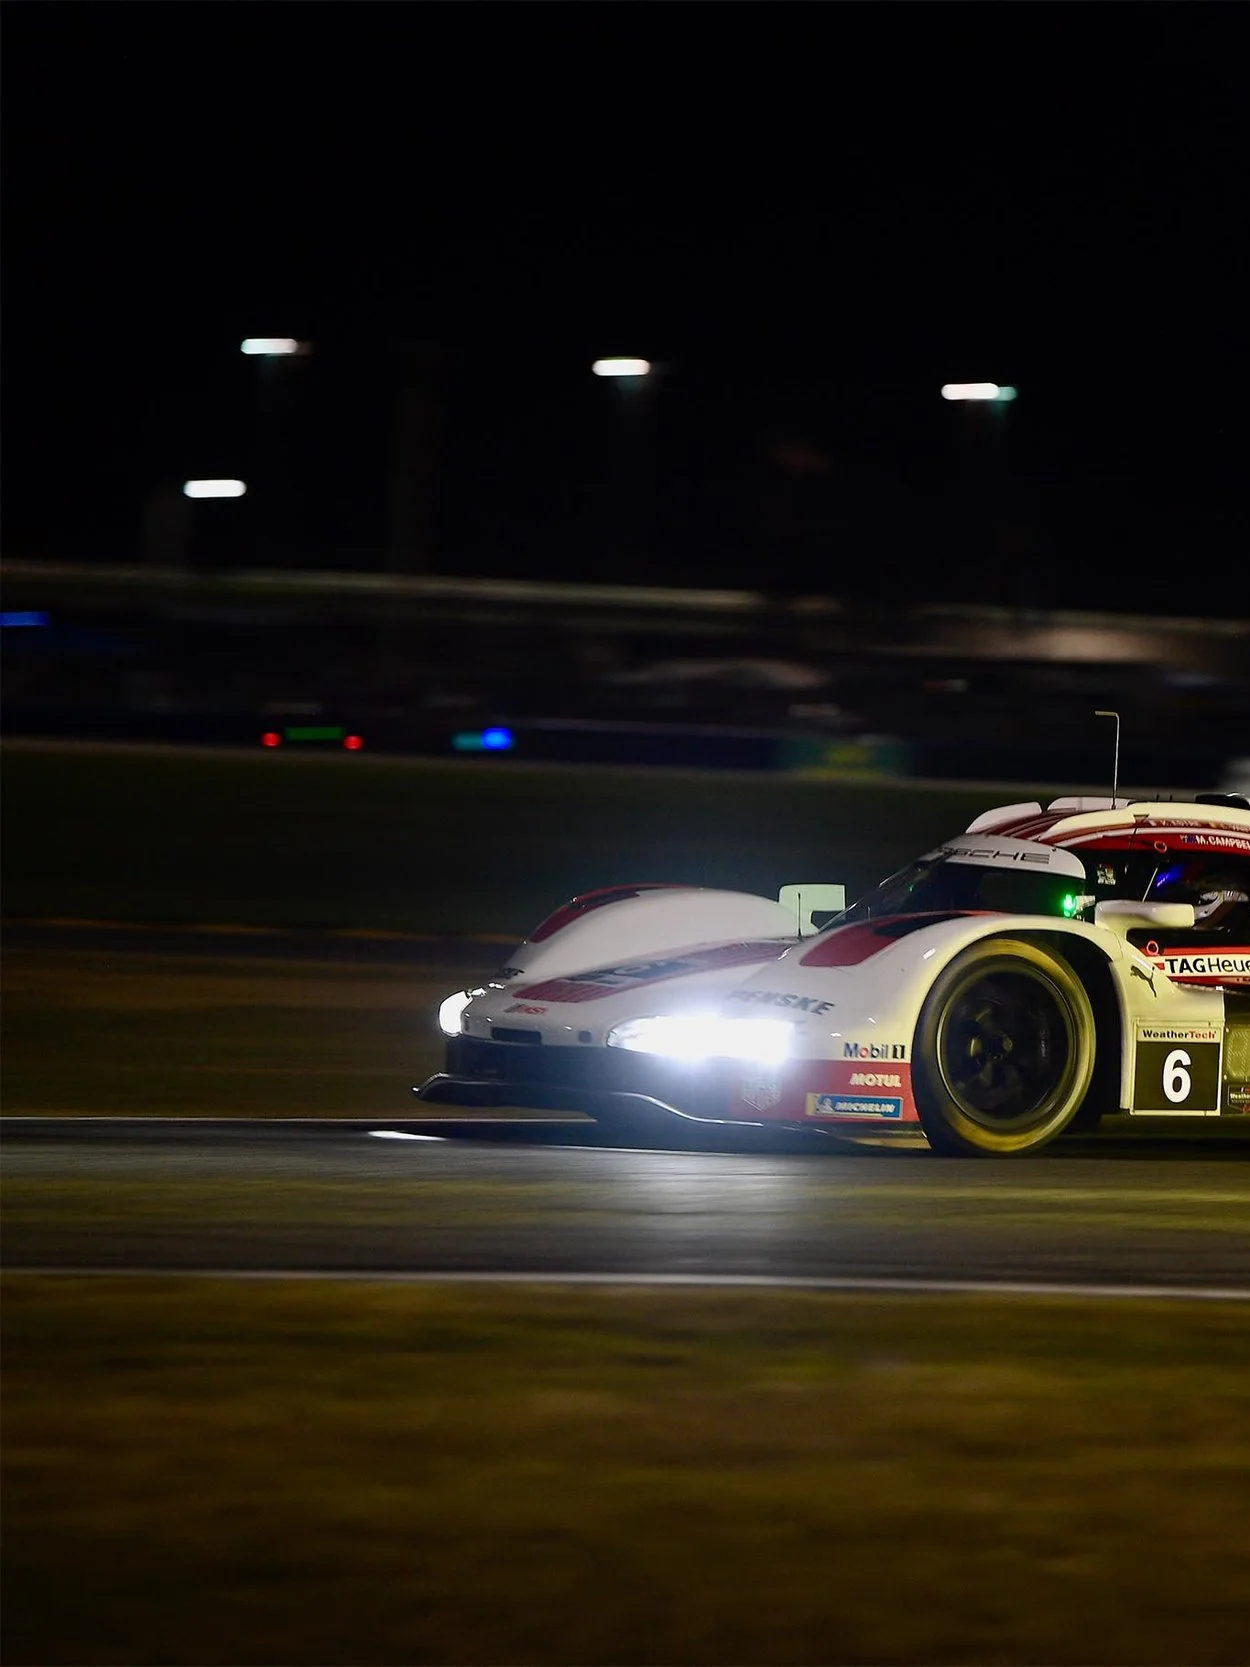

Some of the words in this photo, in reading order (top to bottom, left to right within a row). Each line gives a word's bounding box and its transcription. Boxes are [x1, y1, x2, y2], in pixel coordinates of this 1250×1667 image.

[1142, 1029, 1217, 1040] WeatherTech
[844, 1042, 888, 1059] Mobil
[850, 1073, 902, 1088] MOTUL
[1162, 1049, 1192, 1104] 6
[834, 1101, 896, 1113] MICHELIN
